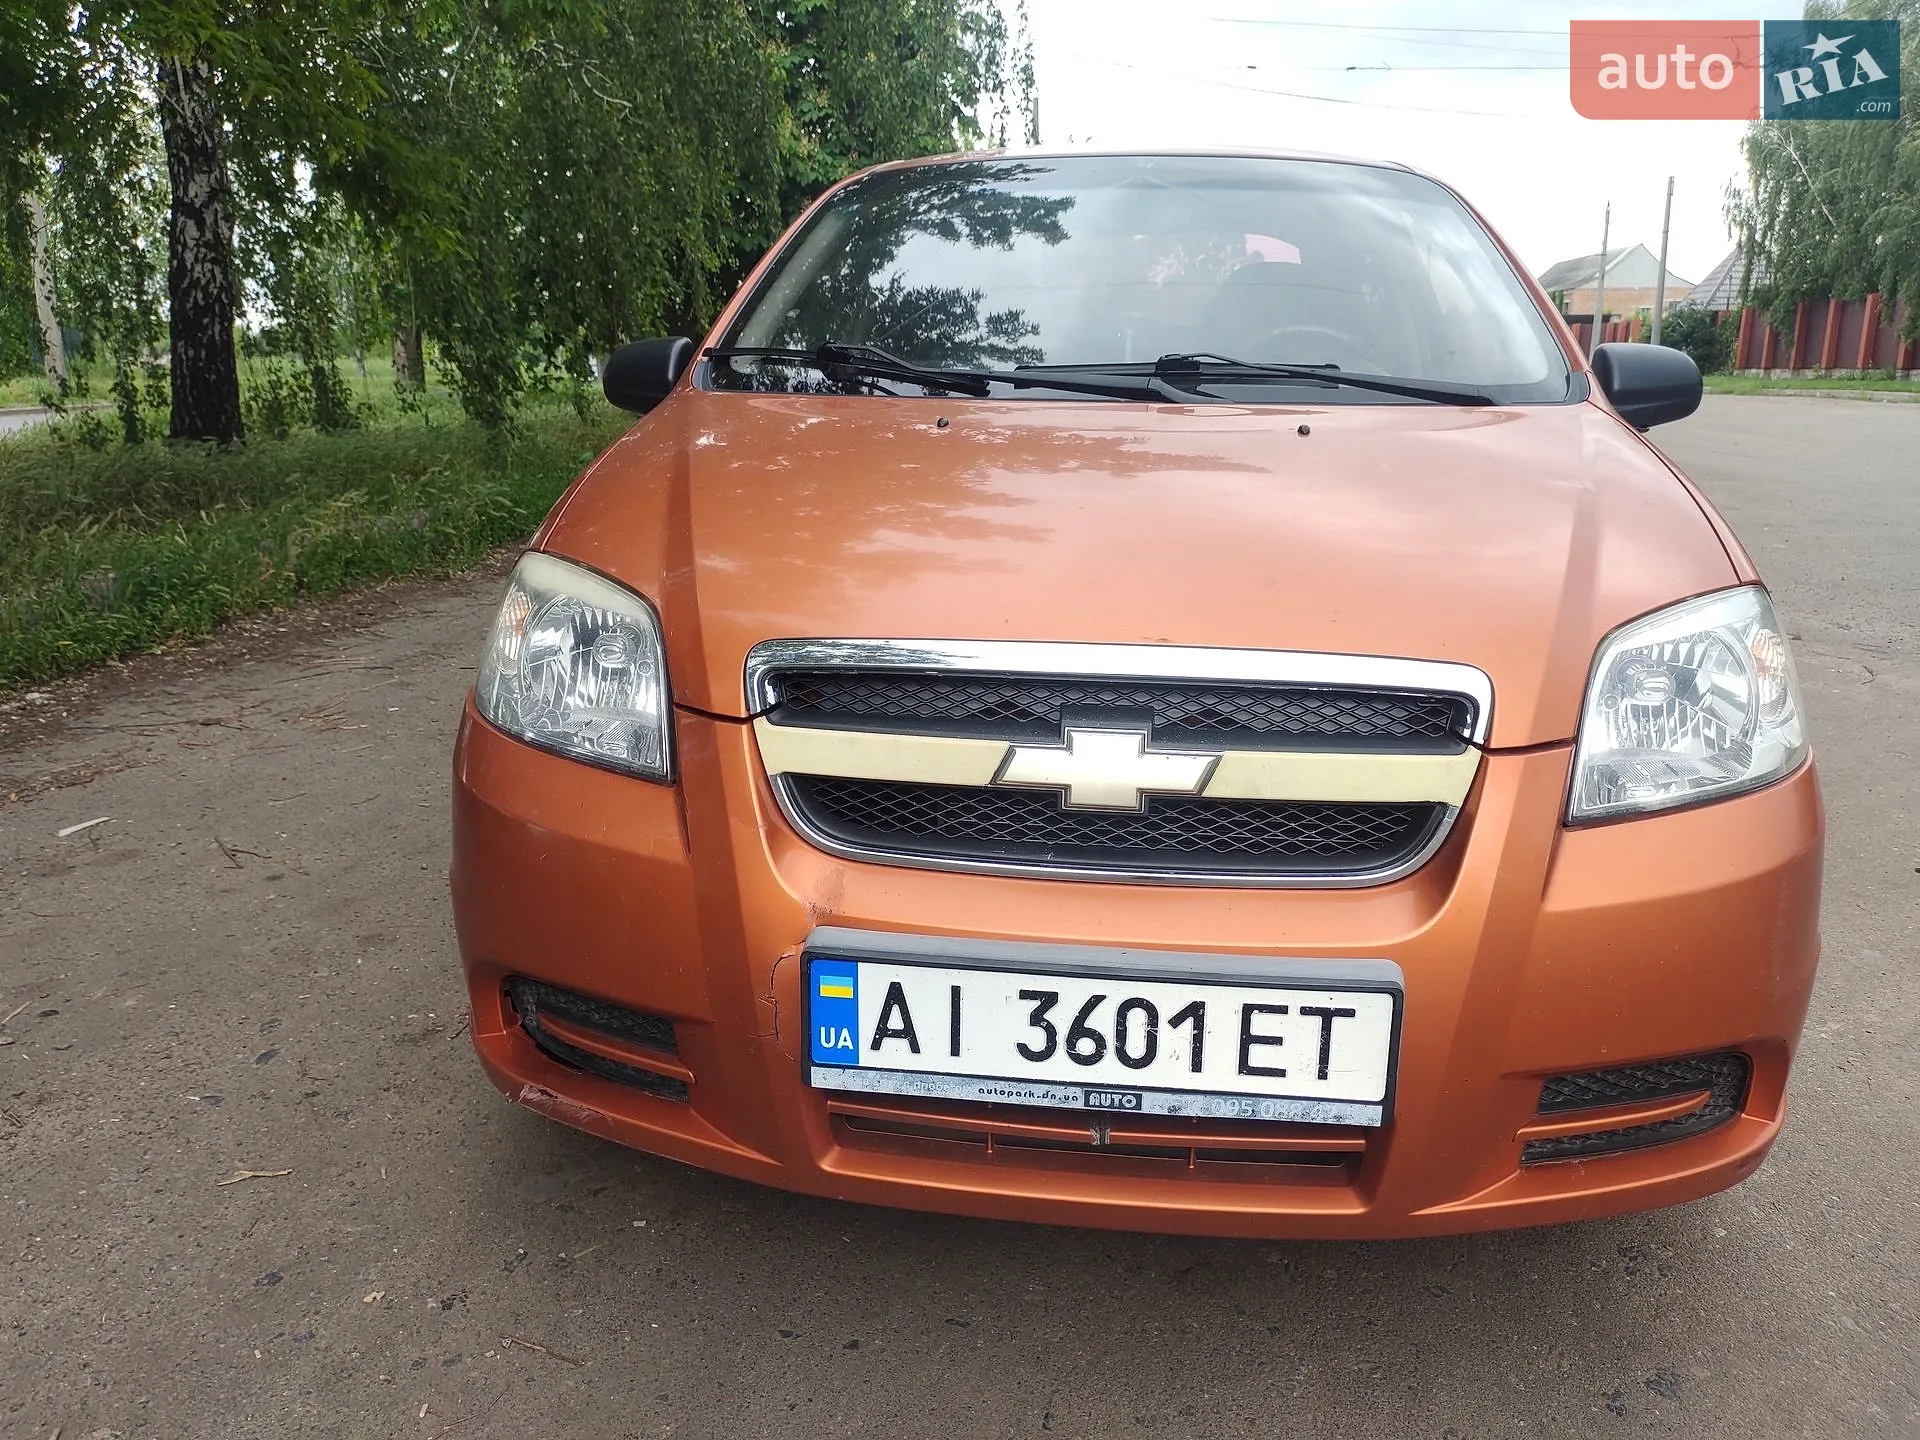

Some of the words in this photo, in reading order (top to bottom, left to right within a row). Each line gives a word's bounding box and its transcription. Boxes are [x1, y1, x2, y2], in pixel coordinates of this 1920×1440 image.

[820, 1026, 854, 1050] UA
[869, 981, 962, 1057] AI
[1016, 989, 1207, 1074] 3601
[1238, 1003, 1357, 1081] ET
[1089, 1092, 1137, 1109] AUTO
